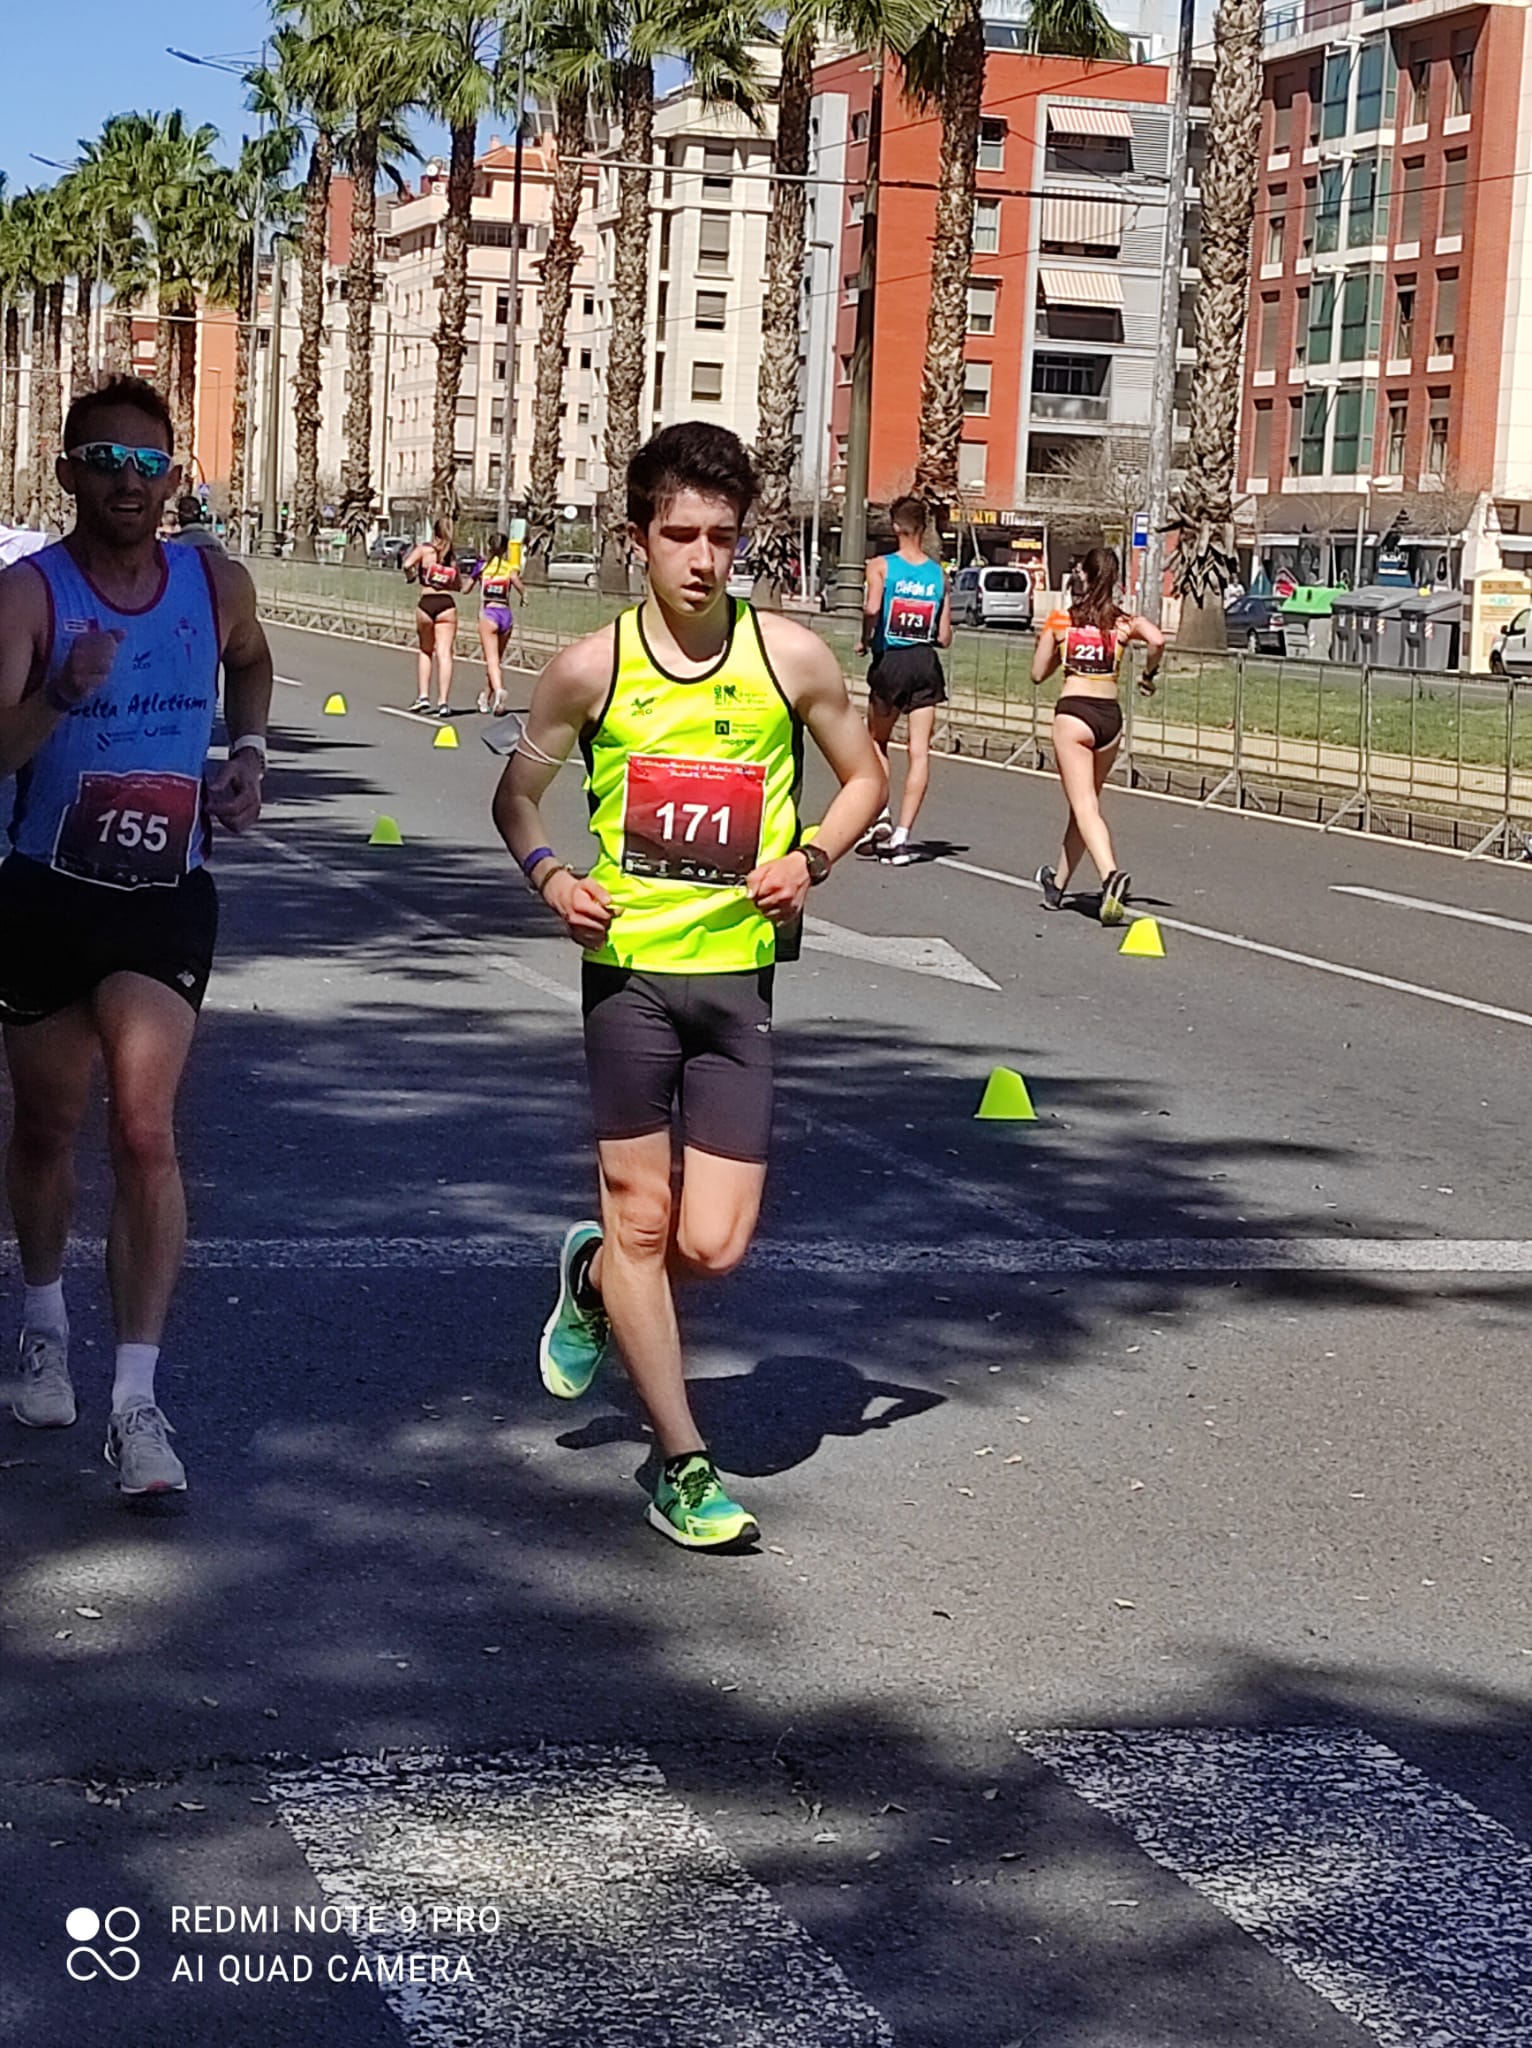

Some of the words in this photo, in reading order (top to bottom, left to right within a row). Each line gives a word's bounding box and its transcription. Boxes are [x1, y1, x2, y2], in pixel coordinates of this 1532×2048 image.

[898, 612, 924, 628] 173
[1074, 644, 1104, 661] 221
[96, 809, 169, 852] 155
[655, 801, 731, 845] 171
